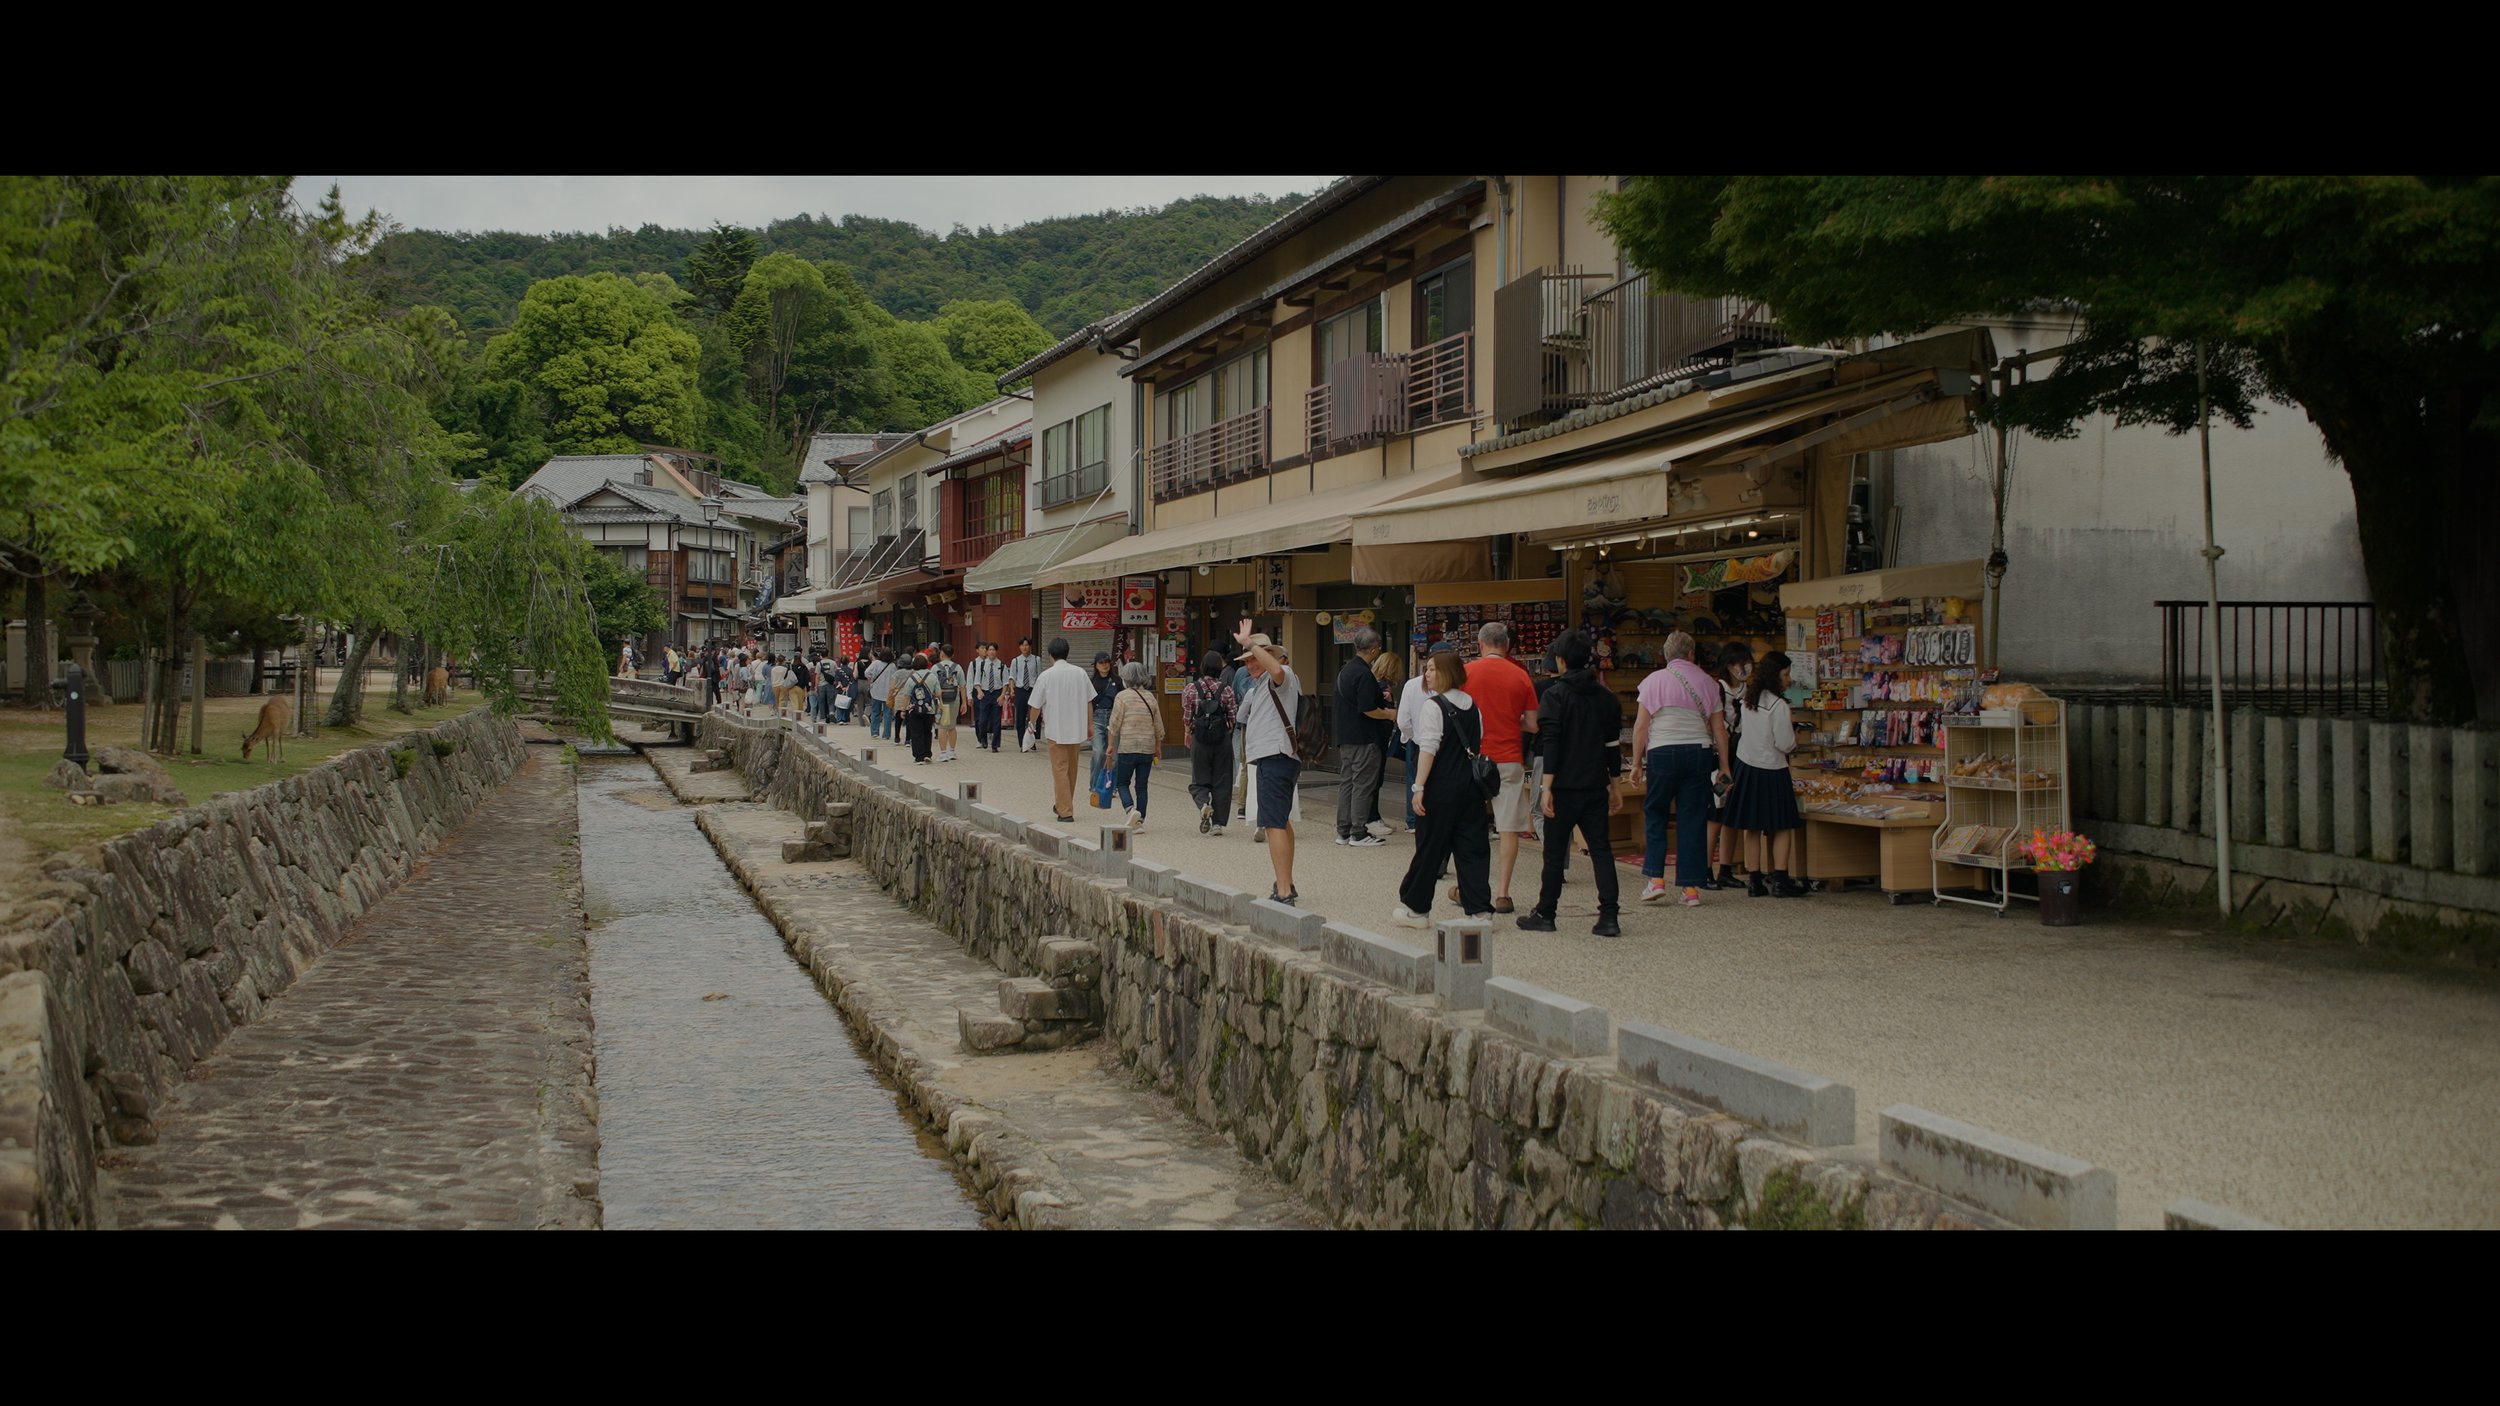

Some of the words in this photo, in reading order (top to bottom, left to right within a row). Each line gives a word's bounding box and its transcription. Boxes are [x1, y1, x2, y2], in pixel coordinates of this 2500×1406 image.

[1269, 562, 1288, 608] 平野屋
[1062, 616, 1097, 628] Cola
